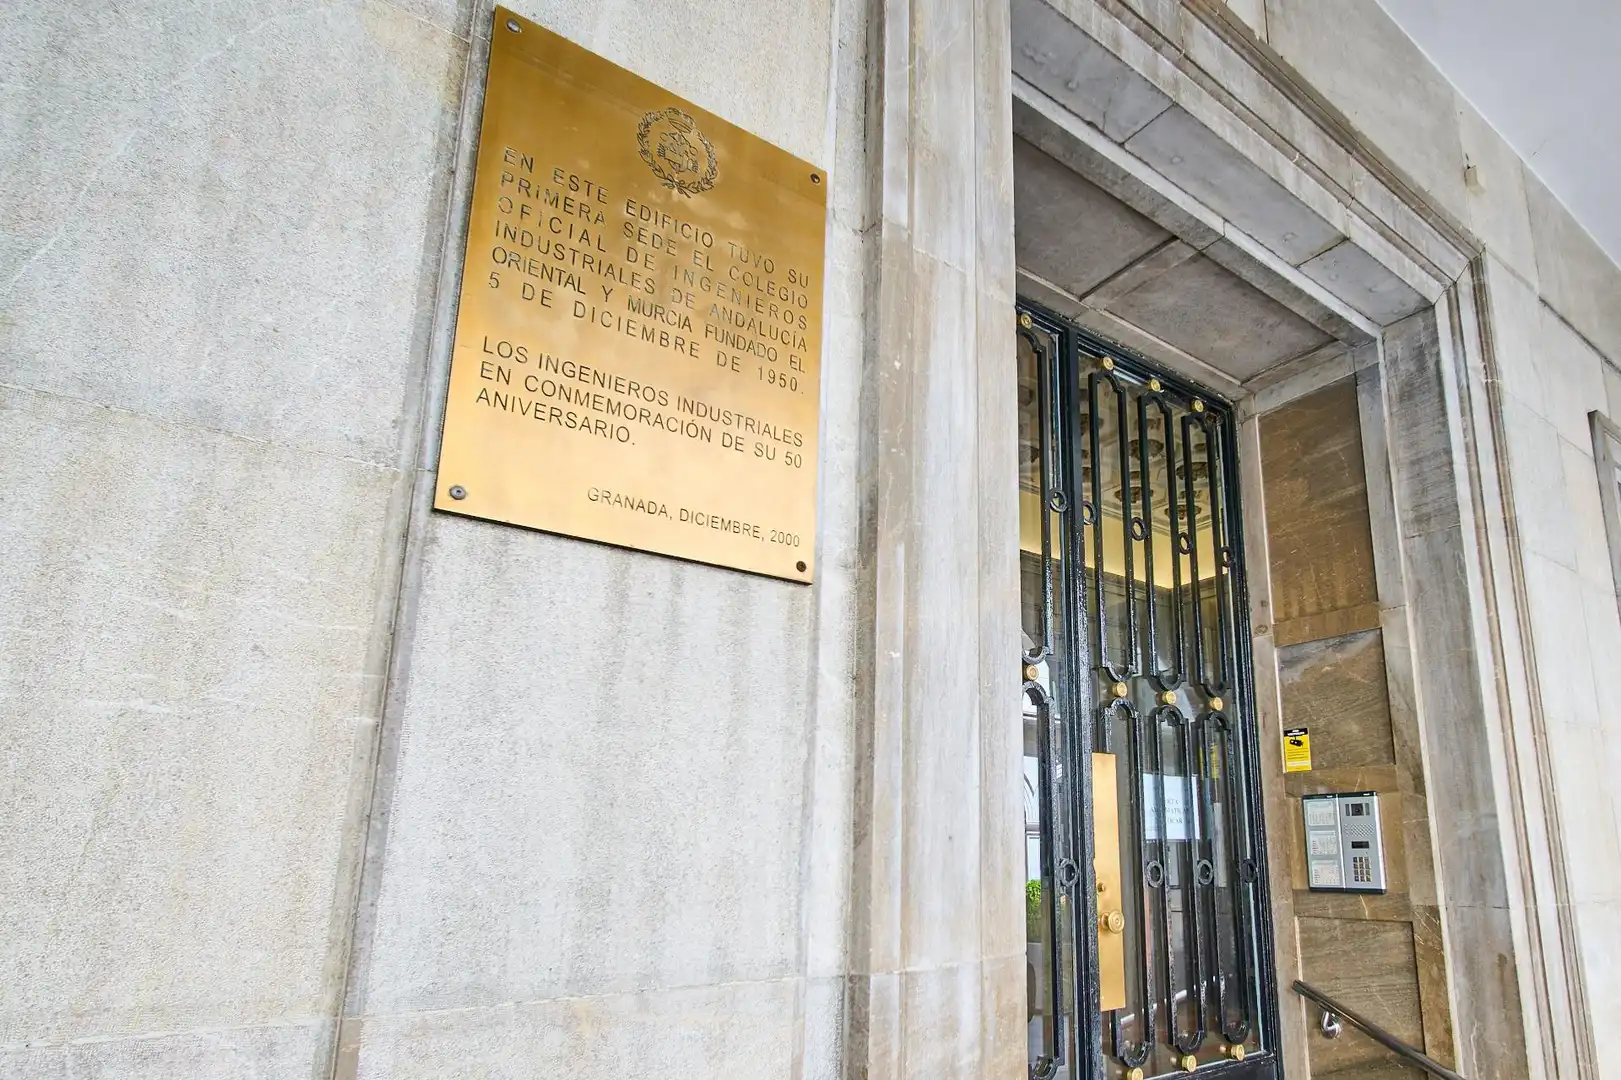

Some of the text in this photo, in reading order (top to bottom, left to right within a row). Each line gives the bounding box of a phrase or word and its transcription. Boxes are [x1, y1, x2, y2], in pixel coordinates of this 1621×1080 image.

[498, 196, 807, 330] OFICIAL DE INGENIEROS
[501, 170, 808, 309] PRIMERA SEDE EL COLEGIO
[504, 146, 808, 288] EN ESTE EDIFICIO TUVO SU
[488, 271, 804, 395] 5 DE DICIEMBRE DE 1950.
[492, 246, 806, 374] ORIENTAL Y MURCIA FUNDADO EL
[495, 220, 807, 352] INDUSTRIALES DE ANDALUCÍA
[475, 387, 635, 446] ANIVERSARIO.
[480, 360, 802, 468] EN CONMEMORACIÓN DE SU 50
[482, 335, 803, 447] LOS INGENIEROS INDUSTRIALES
[587, 487, 800, 548] GRANADA, DICIEMBRE, 2000
